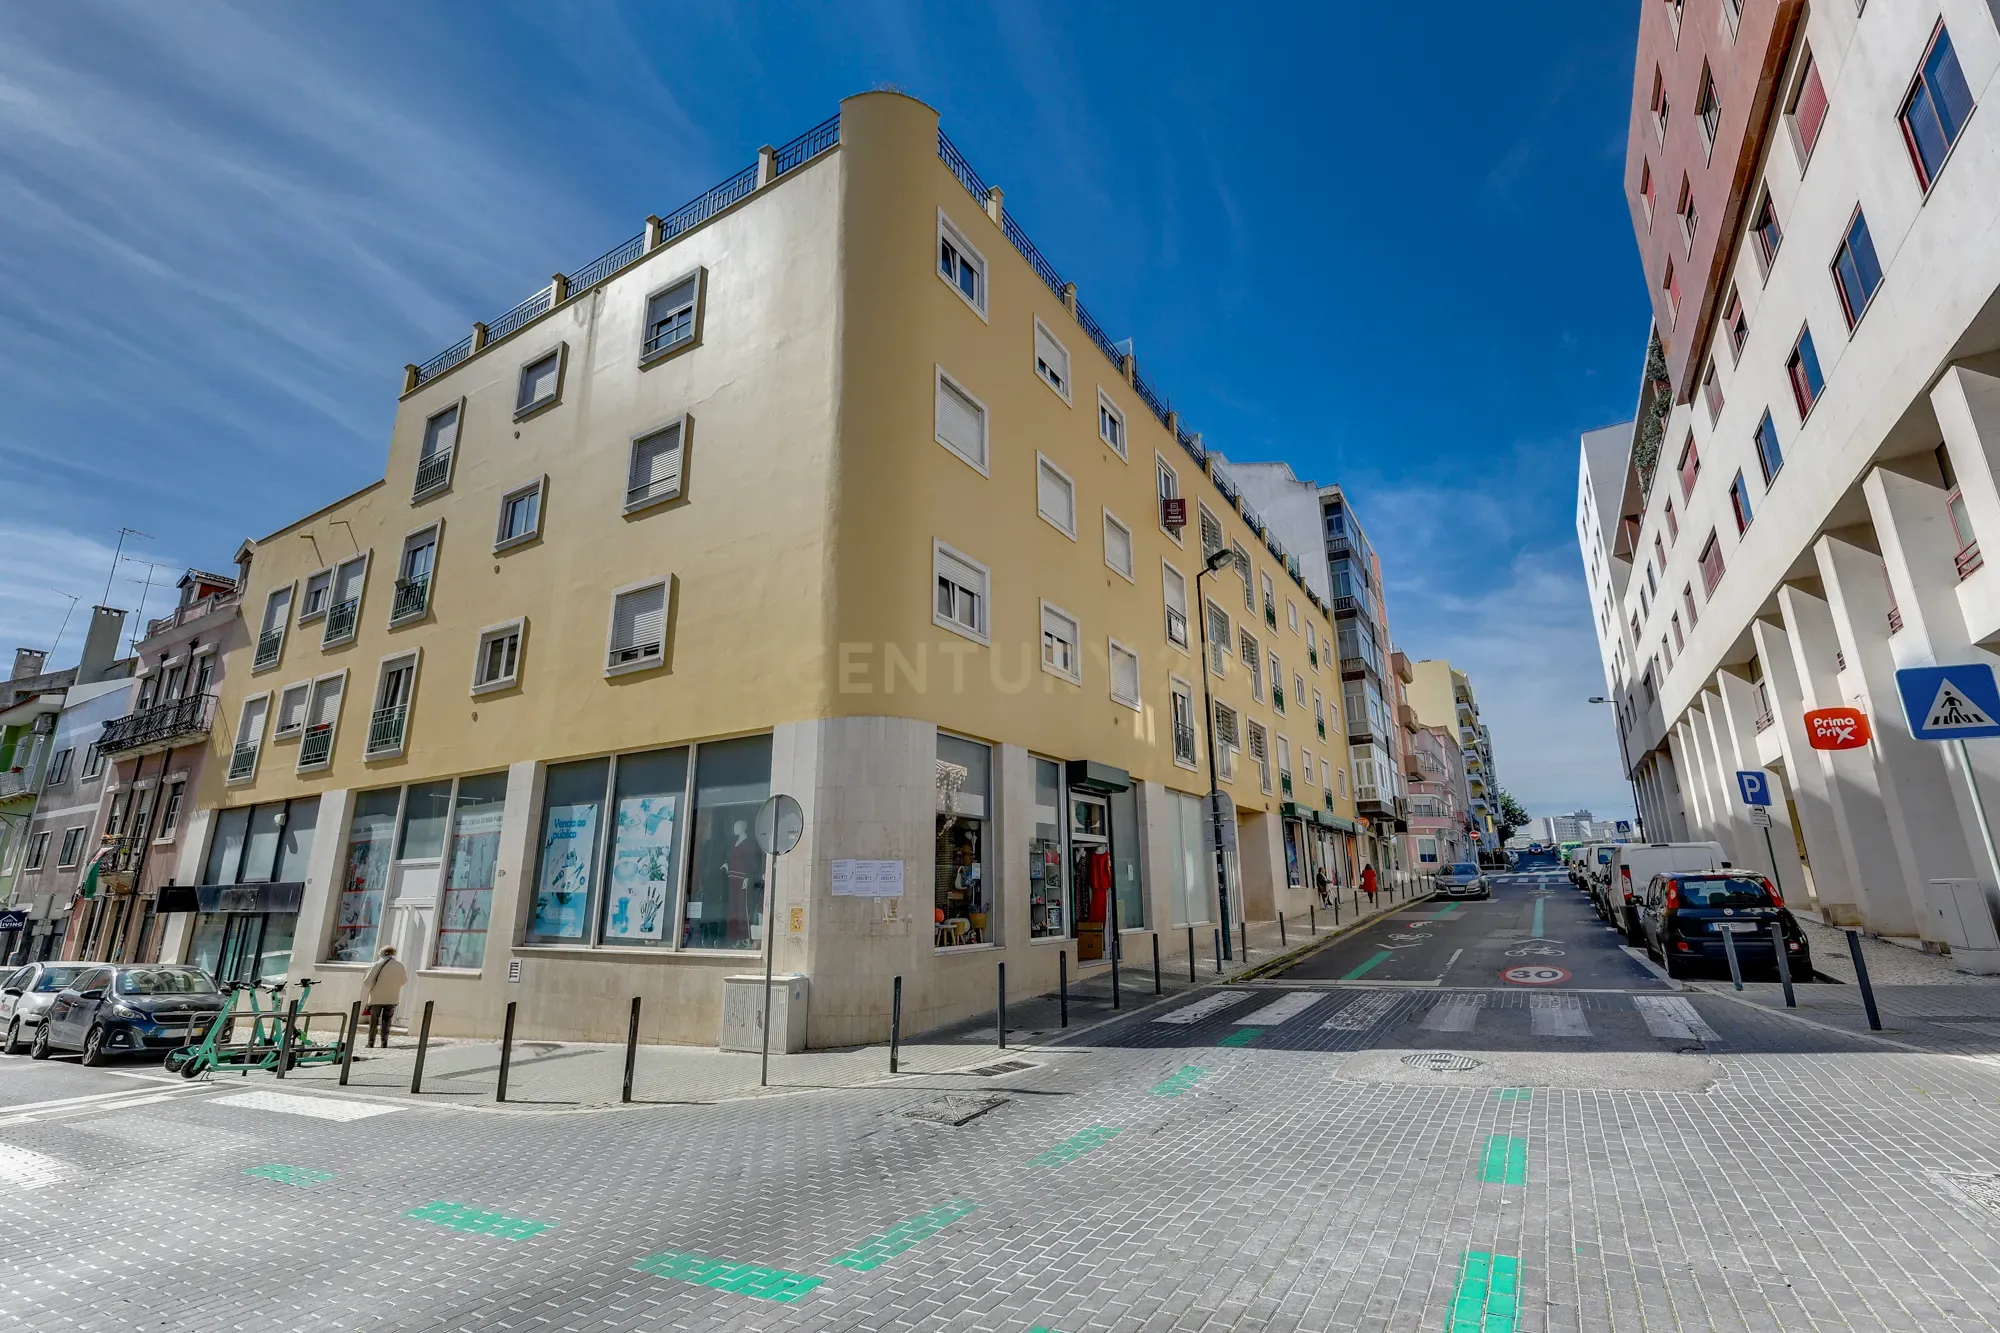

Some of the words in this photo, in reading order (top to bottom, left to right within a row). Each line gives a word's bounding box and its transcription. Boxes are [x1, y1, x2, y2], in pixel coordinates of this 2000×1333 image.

[1813, 716, 1855, 728] Prima
[1742, 774, 1761, 802] P
[554, 818, 576, 828] Venda
[577, 819, 586, 827] ao
[1511, 970, 1559, 979] 30
